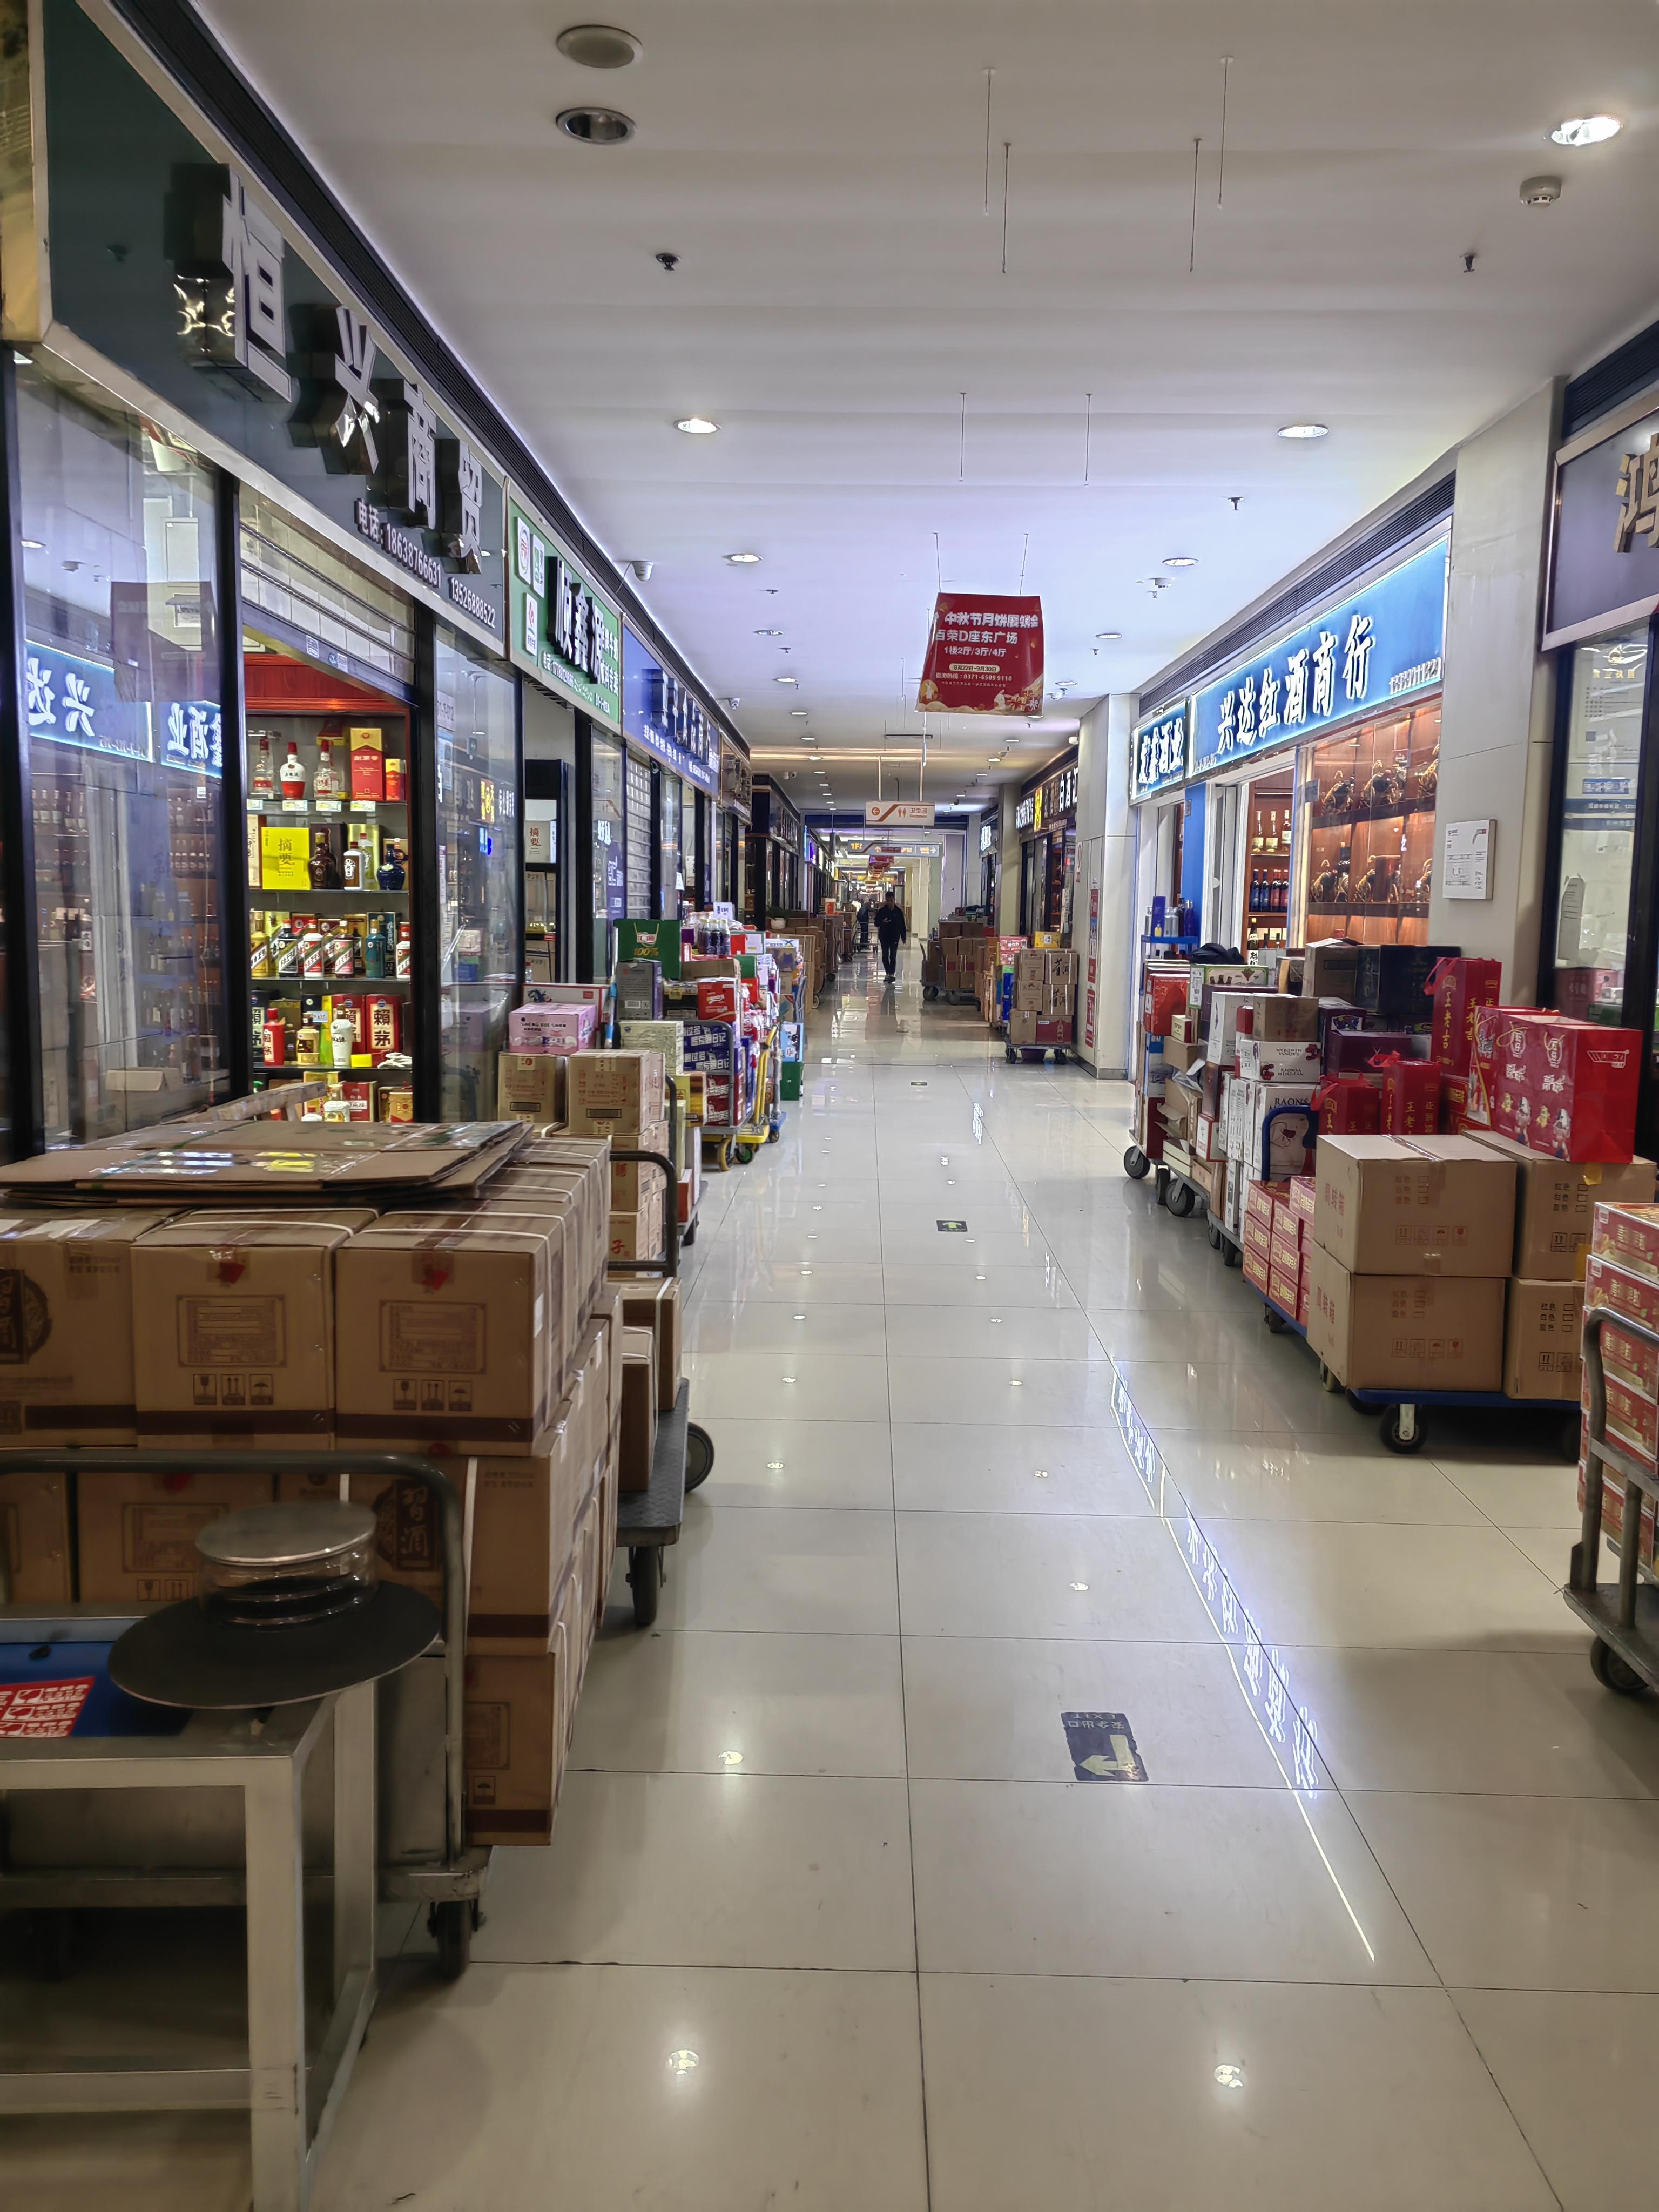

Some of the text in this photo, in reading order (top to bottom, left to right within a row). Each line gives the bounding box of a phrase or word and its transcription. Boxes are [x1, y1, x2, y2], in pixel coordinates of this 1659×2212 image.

[222, 165, 482, 561] 恒兴商贸
[451, 577, 495, 629] 13526888522
[944, 611, 1039, 629] 中秋节月饼展销会
[935, 629, 1018, 644] 百荣D座东广场
[945, 646, 1006, 657] 1楼2厅/3厅/4厅
[954, 664, 997, 672] 8月22日-9月30日
[1593, 669, 1635, 679] 营业执照
[1216, 614, 1377, 754] 兴达红酒商行
[529, 827, 542, 847] 摘要
[278, 838, 293, 865] 摘要
[1444, 991, 1452, 1049] 王老吉
[1405, 1102, 1416, 1134] 王老
[1068, 1721, 1125, 1729] 安全出口
